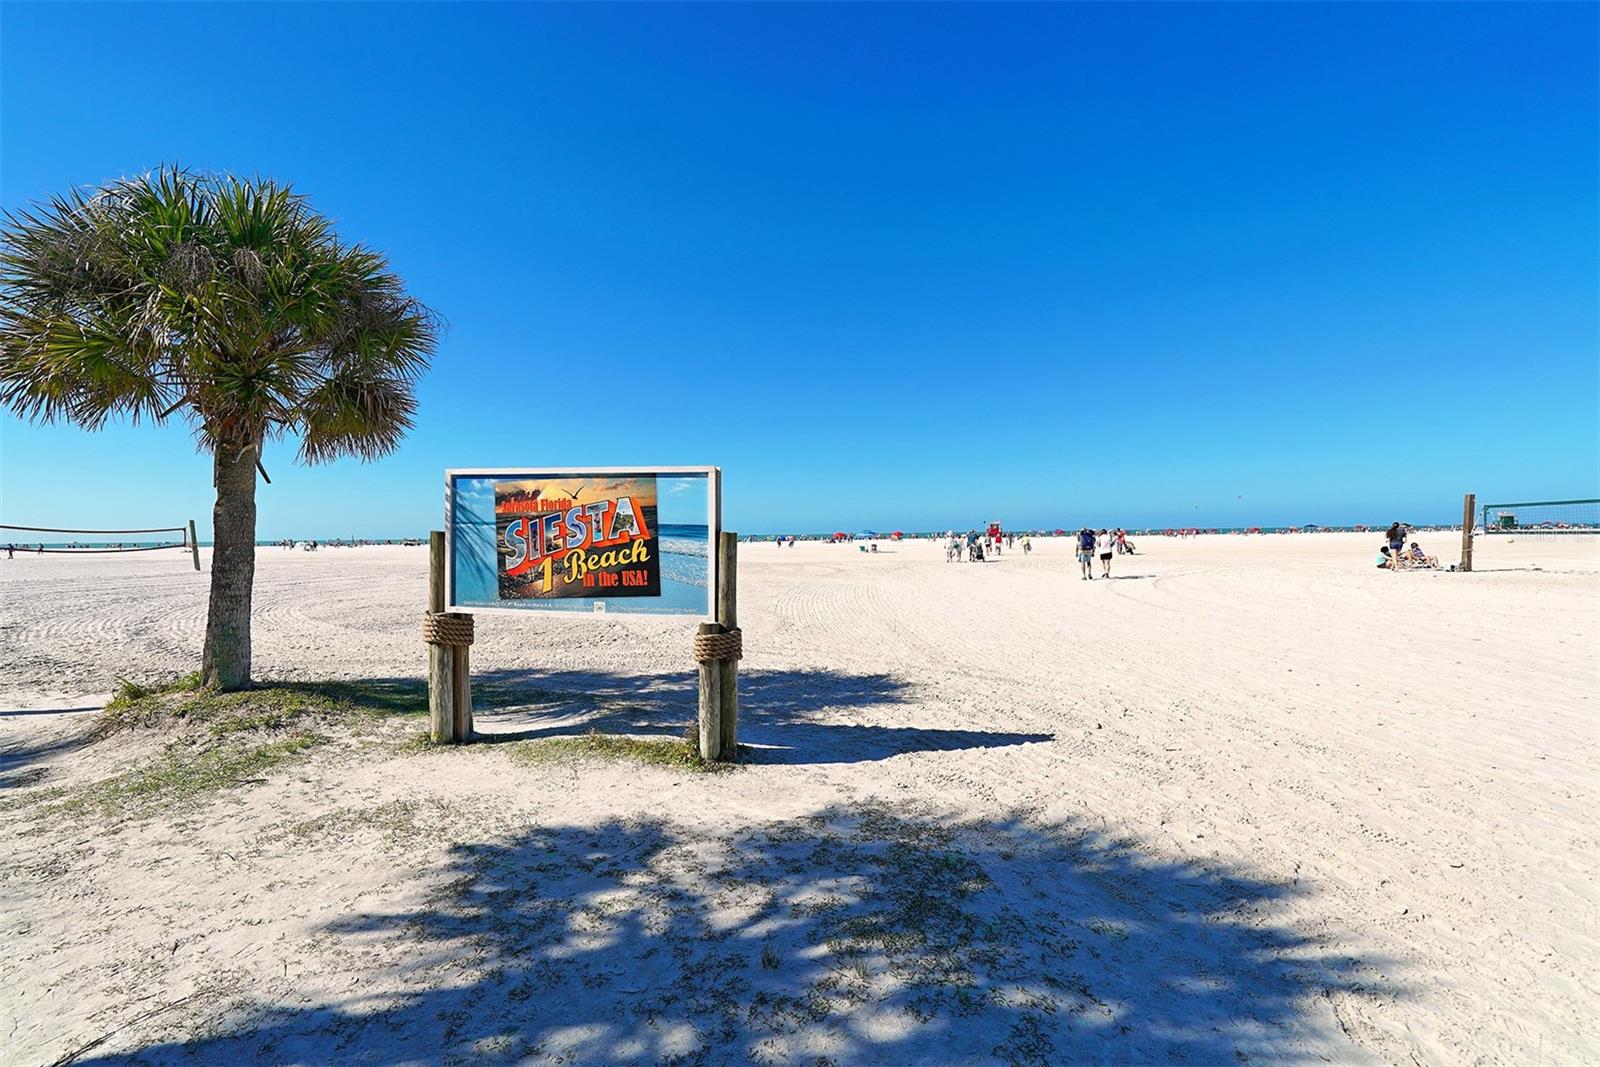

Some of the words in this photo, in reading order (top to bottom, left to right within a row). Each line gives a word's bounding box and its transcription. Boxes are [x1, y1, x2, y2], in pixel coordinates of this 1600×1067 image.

[541, 498, 573, 512] Florida
[505, 497, 645, 572] SIESTA
[563, 538, 651, 583] Beach
[598, 571, 619, 587] the
[621, 570, 648, 587] USA!
